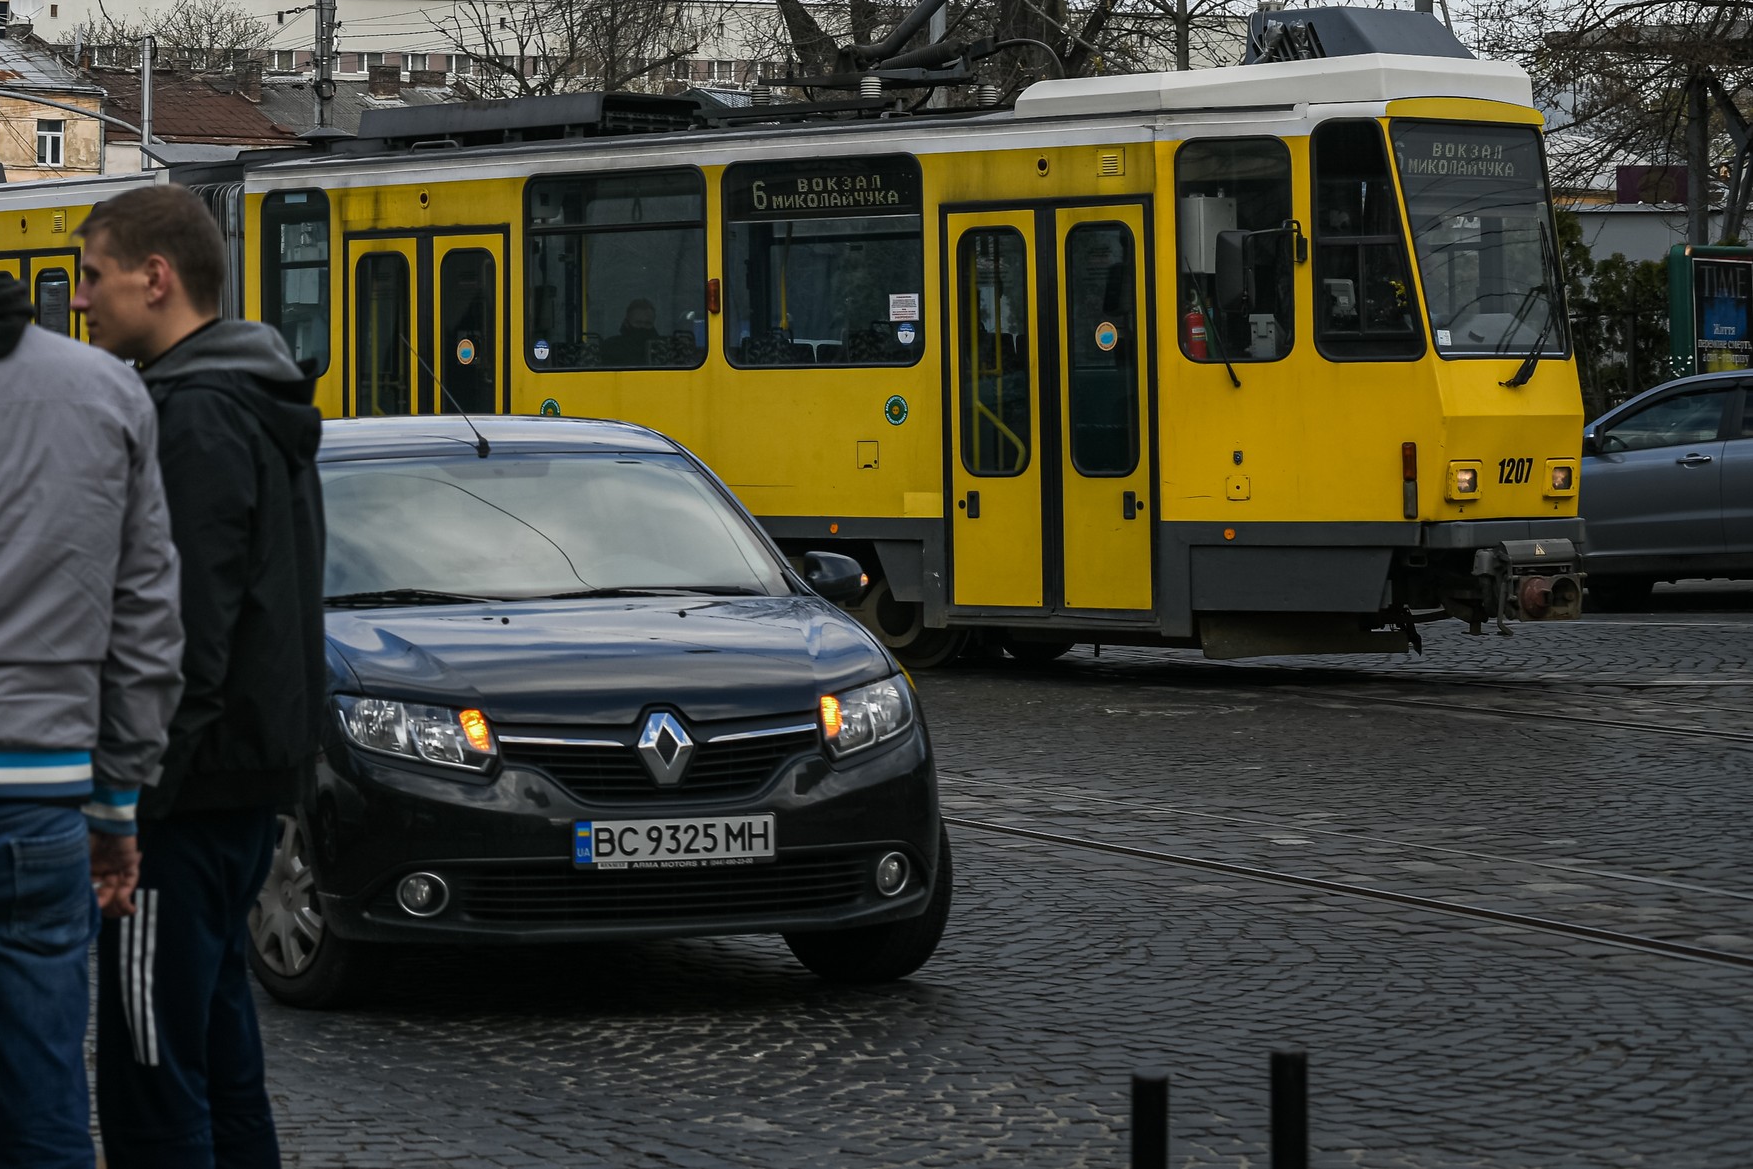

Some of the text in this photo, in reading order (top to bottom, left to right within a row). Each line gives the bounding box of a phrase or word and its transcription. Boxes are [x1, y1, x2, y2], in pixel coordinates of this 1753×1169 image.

[1432, 142, 1503, 159] ВОКЗАЛ
[752, 175, 881, 210] 6 ВОКЗАЛ
[1700, 265, 1747, 299] TIME
[1713, 324, 1736, 335] Життя
[1498, 457, 1533, 484] 1207
[577, 821, 769, 857] UA BC 9325 MH
[660, 860, 697, 868] MOTORS
